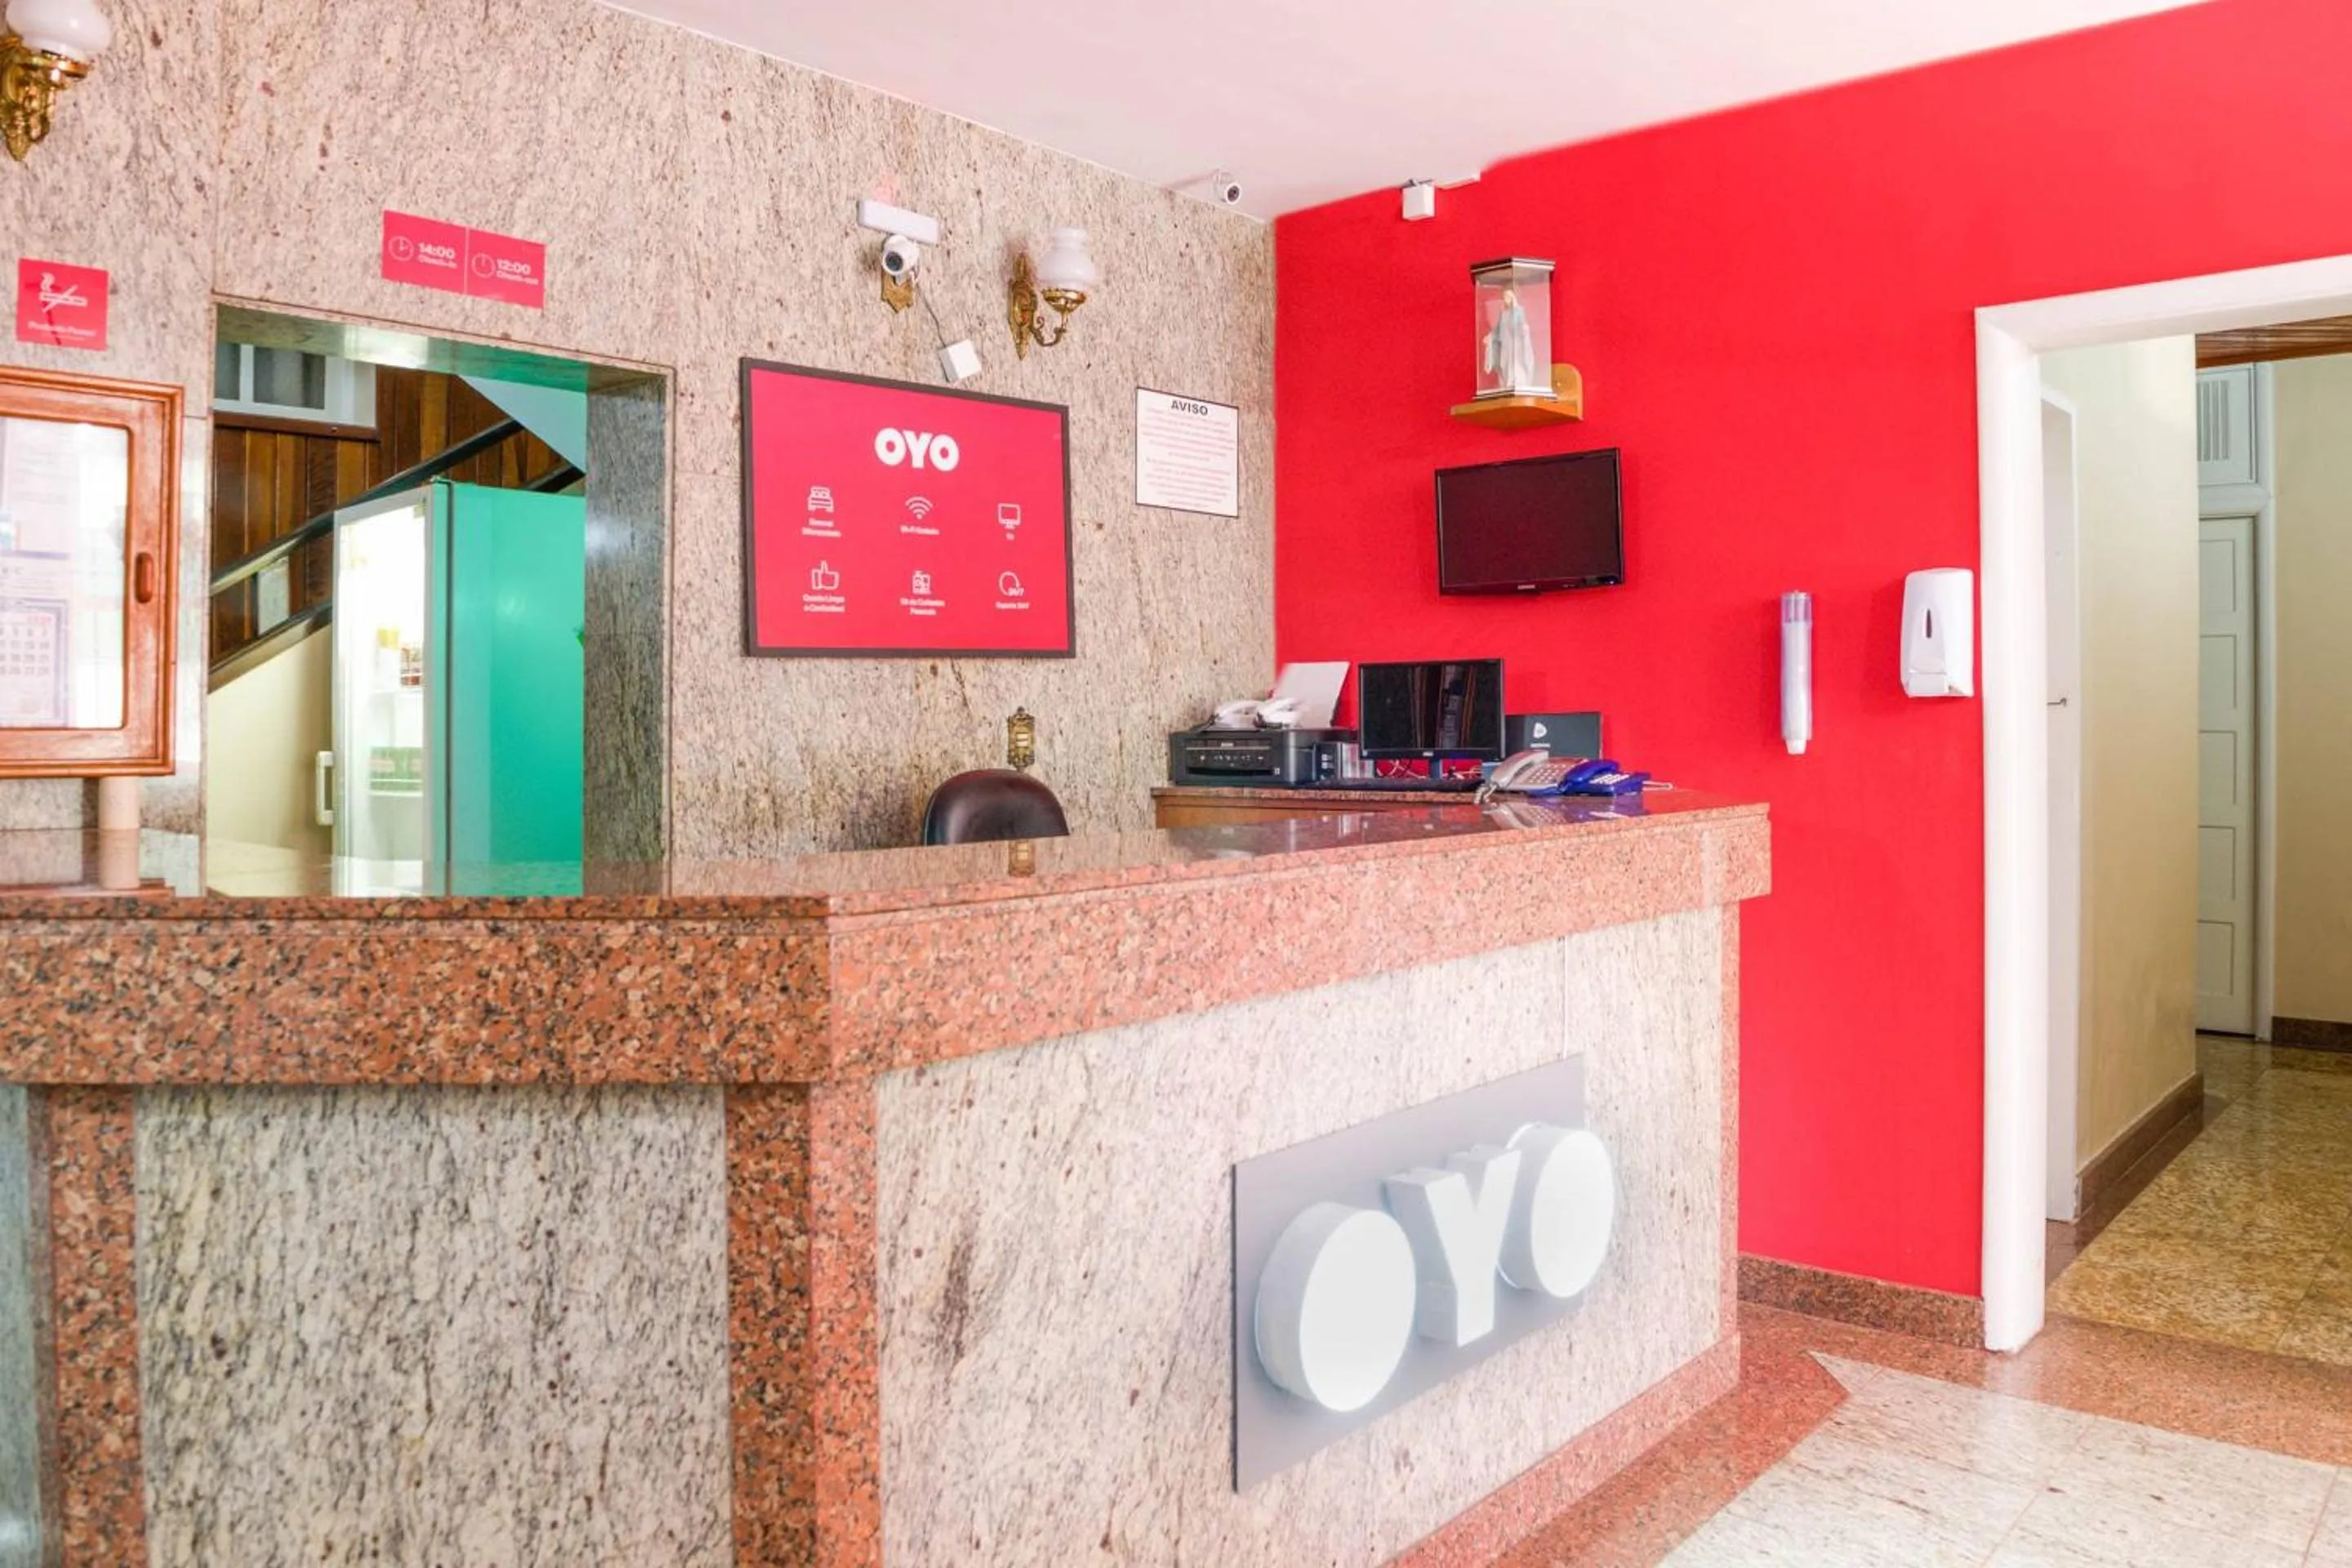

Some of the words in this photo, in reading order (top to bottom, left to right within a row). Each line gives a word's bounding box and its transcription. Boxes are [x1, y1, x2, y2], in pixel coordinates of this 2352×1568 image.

[417, 243, 456, 259] 14:00
[497, 259, 532, 274] 12:00
[1171, 399, 1209, 416] AVISO
[874, 427, 960, 471] OYO
[1254, 1122, 1615, 1412] OYO
